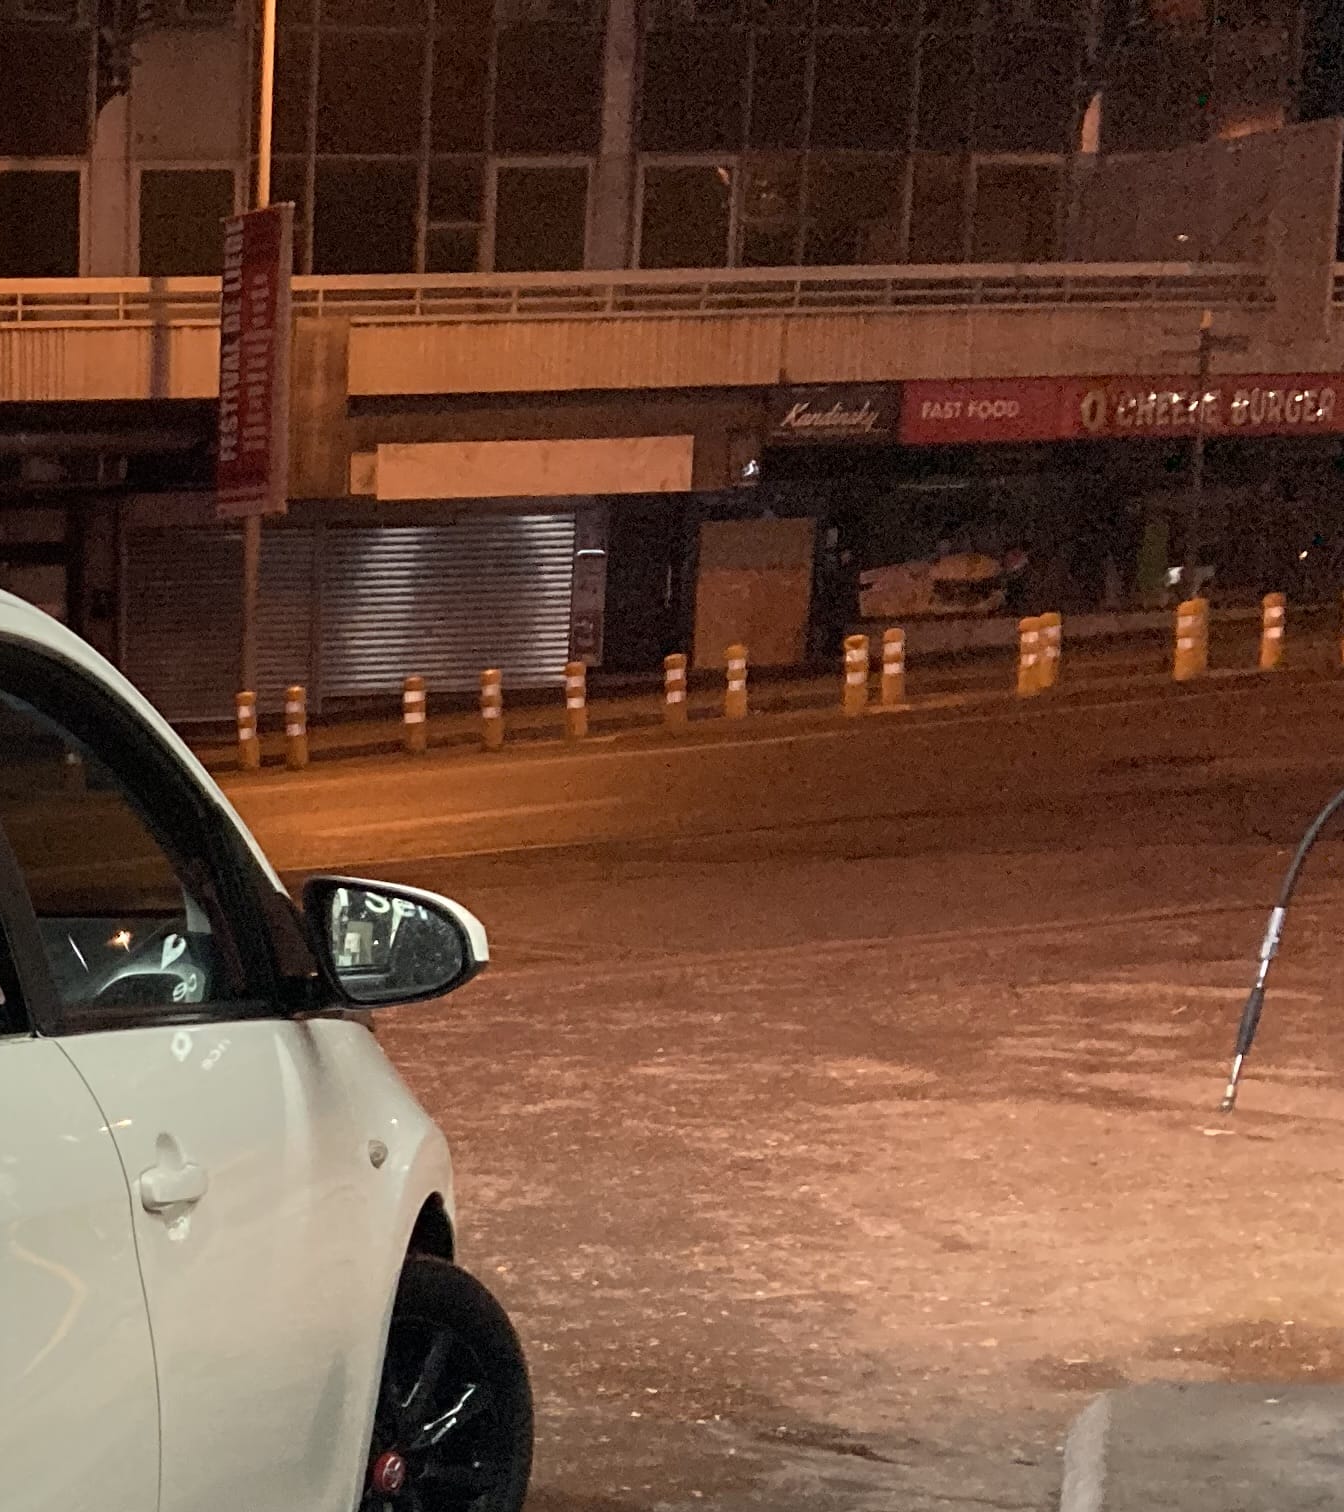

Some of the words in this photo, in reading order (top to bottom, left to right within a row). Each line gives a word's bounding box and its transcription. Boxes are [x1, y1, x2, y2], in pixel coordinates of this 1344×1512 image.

[921, 399, 962, 419] FAST
[967, 399, 1020, 419] FOOD
[1231, 387, 1336, 427] BURGER
